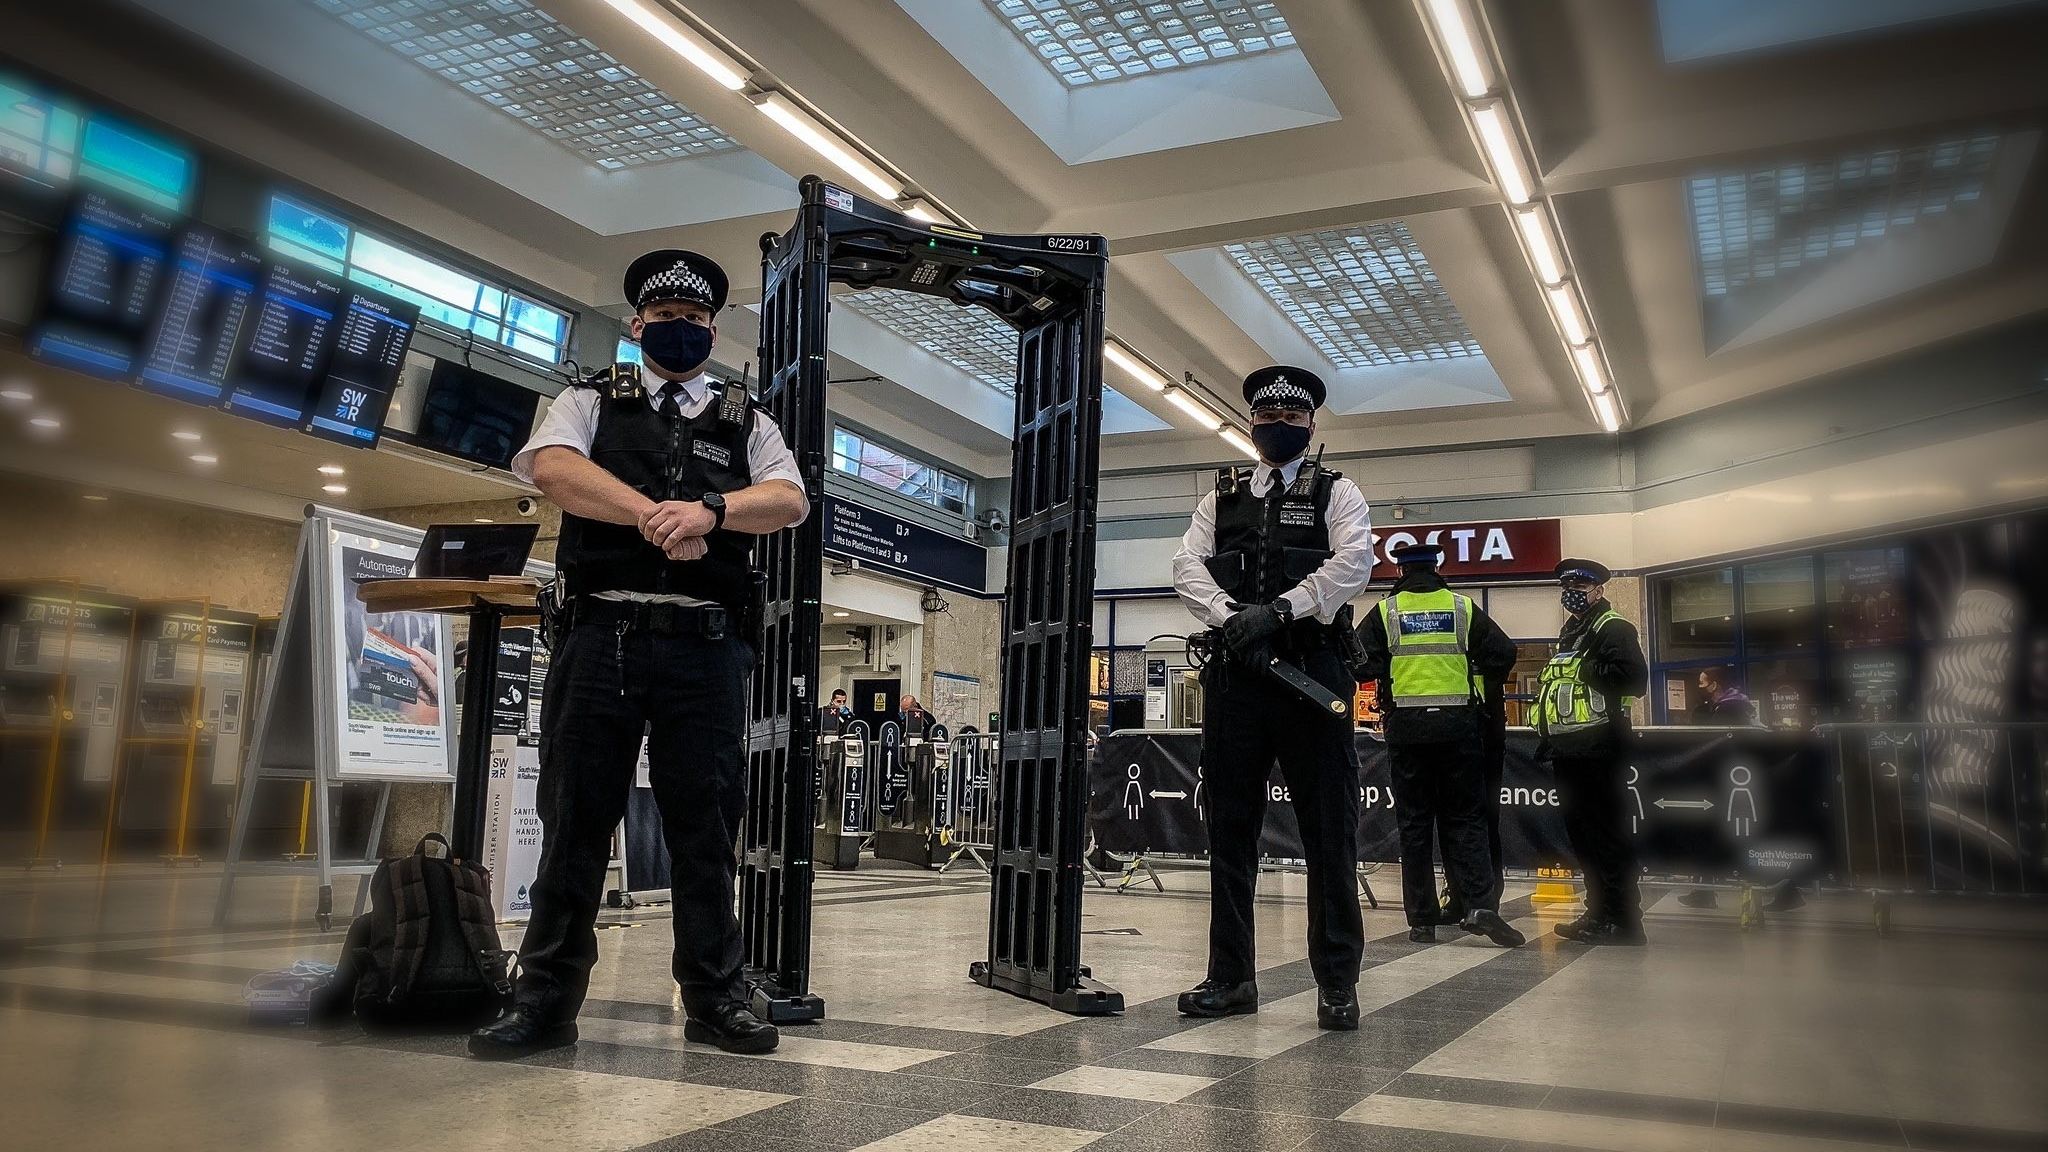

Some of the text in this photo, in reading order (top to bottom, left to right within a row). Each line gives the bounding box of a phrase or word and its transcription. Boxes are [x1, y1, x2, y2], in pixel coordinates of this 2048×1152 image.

[1048, 237, 1090, 250] 6/22/91
[271, 273, 312, 293] London Waterloo
[316, 280, 336, 293] Platform
[359, 297, 390, 314] Departures
[341, 388, 367, 407] SW
[347, 406, 360, 421] R
[693, 449, 729, 467] POLICE OFFICER
[834, 504, 861, 520] Platform 3
[855, 522, 873, 532] Wimbledon
[832, 534, 846, 545] Lifts
[845, 538, 852, 547] to
[852, 540, 875, 554] Platforms
[878, 549, 887, 557] and
[887, 549, 891, 558] 3
[359, 556, 407, 576] Automated
[182, 622, 217, 634] TICKTS
[206, 636, 247, 647] Card Payments
[500, 641, 532, 652] South Western
[503, 648, 521, 658] Railway
[368, 682, 381, 691] SWR
[1771, 692, 1784, 702] The
[492, 758, 509, 768] SW
[499, 769, 506, 778] R
[521, 773, 538, 781] Railway
[1500, 787, 1560, 807] ance
[492, 794, 501, 832] STATION
[519, 818, 539, 826] YOUR
[516, 828, 541, 836] HANDS
[489, 837, 497, 884] ANITISER
[1749, 849, 1812, 860] South Western
[1758, 858, 1791, 870] Railway
